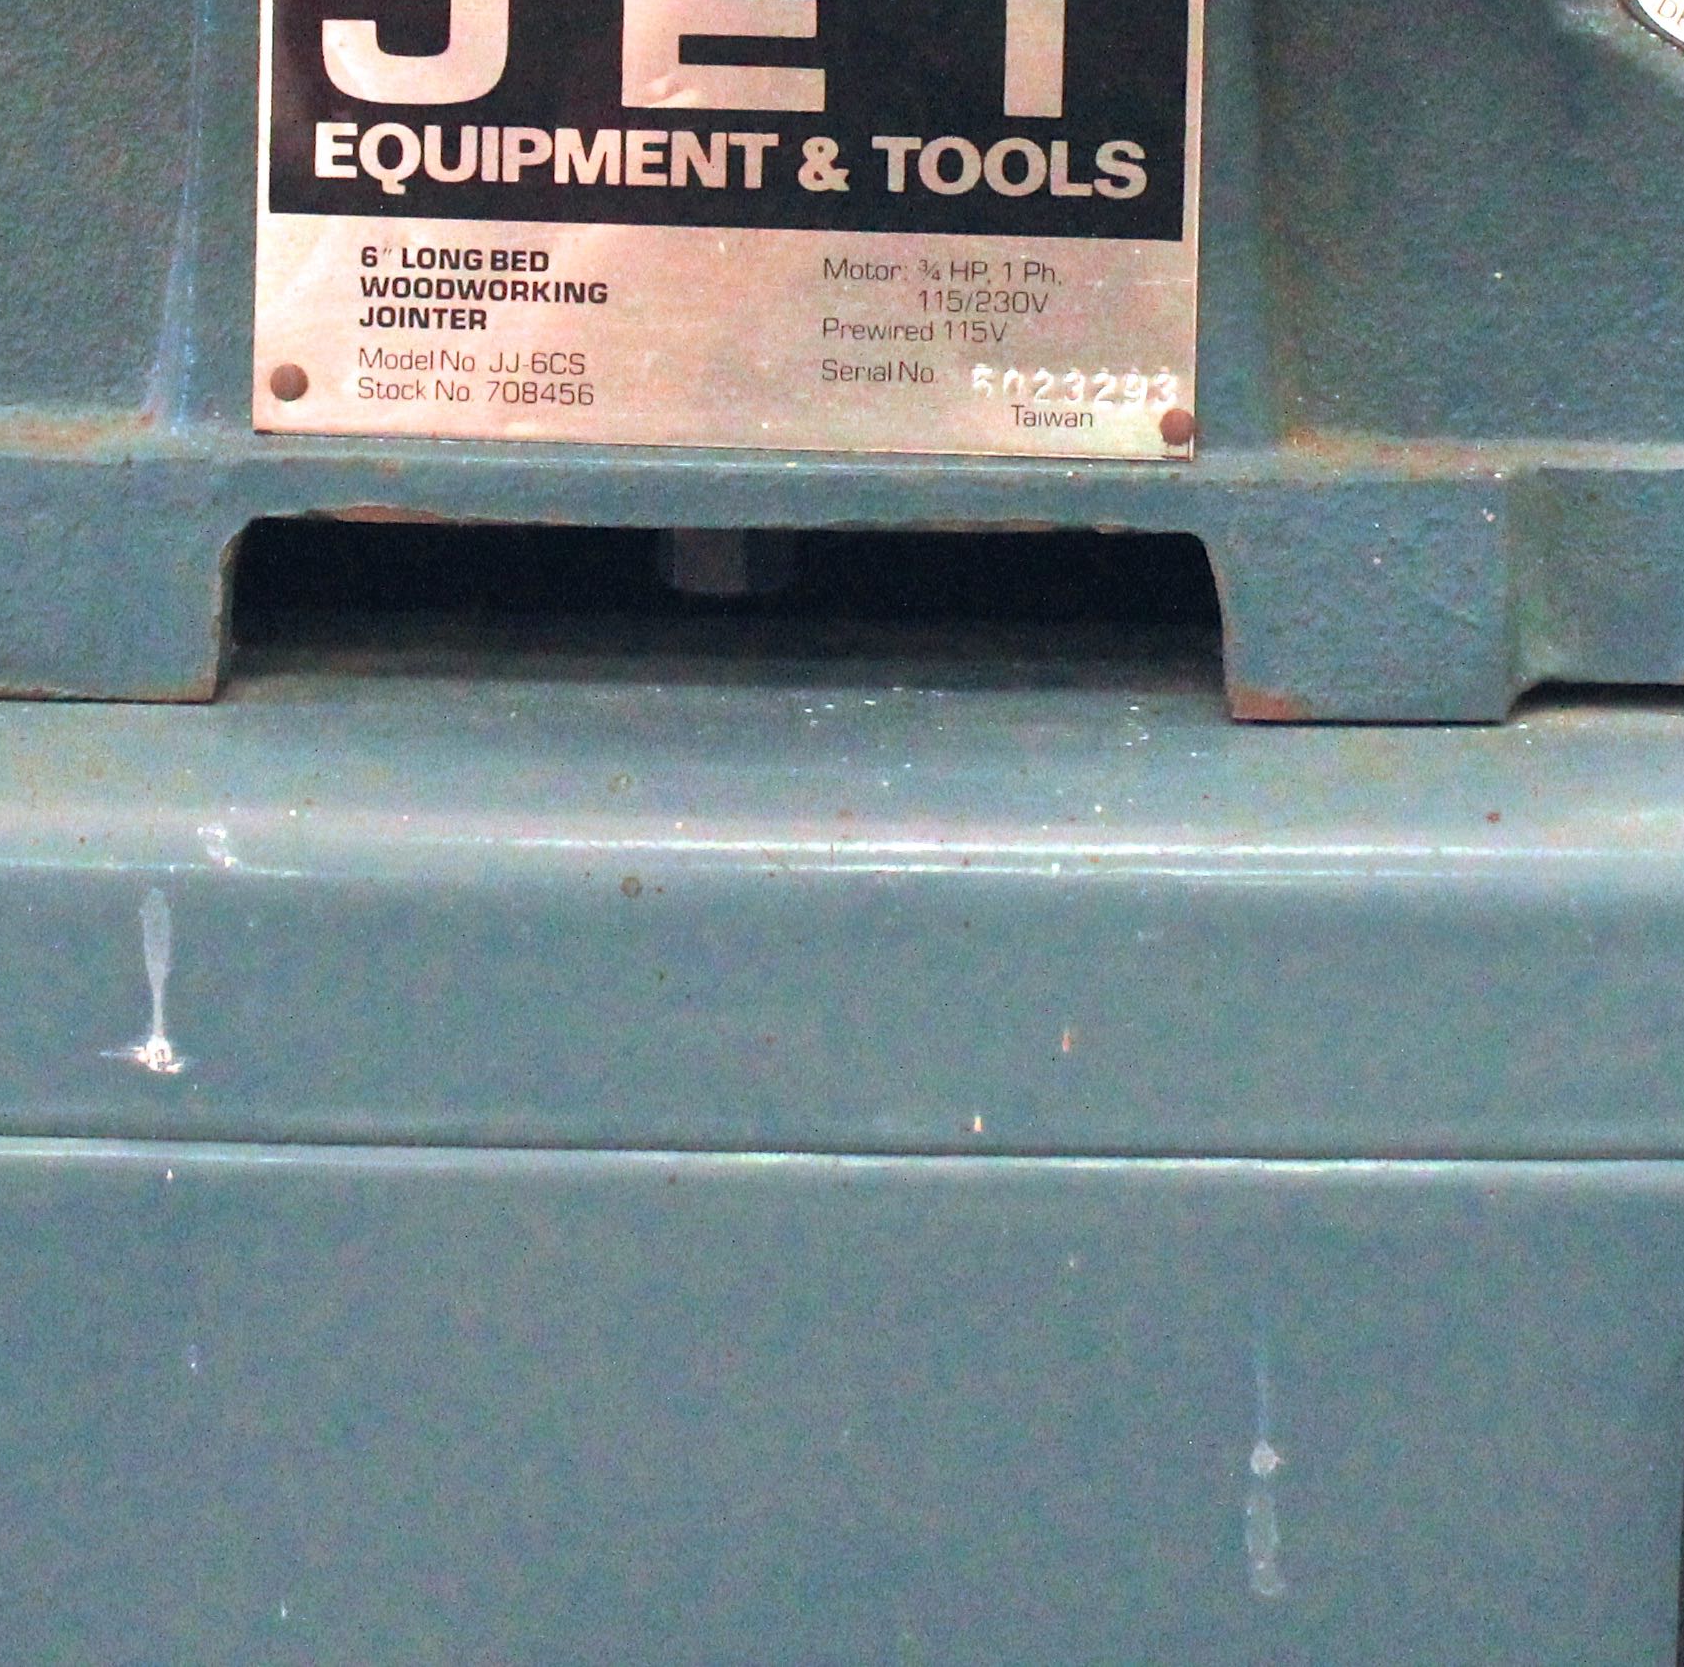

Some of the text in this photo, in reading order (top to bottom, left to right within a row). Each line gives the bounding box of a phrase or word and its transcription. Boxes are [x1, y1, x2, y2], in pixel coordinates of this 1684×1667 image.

[315, 121, 1148, 198] EQUIPMENT & TOOLS
[402, 247, 483, 271] LONG
[490, 249, 549, 272] BED
[824, 258, 908, 281] Motor:
[1003, 262, 1011, 281] 1
[360, 276, 608, 304] WOODWORKING
[919, 290, 1048, 314] 115/230V
[359, 306, 487, 330] JOINTER
[823, 317, 1008, 343] Prewired 115V
[359, 347, 433, 370] Model
[489, 352, 586, 376] JJ-6CS
[822, 359, 891, 382] Serial
[358, 376, 426, 400] Stock
[486, 381, 594, 406] 708456
[1011, 404, 1093, 427] Taiwan
